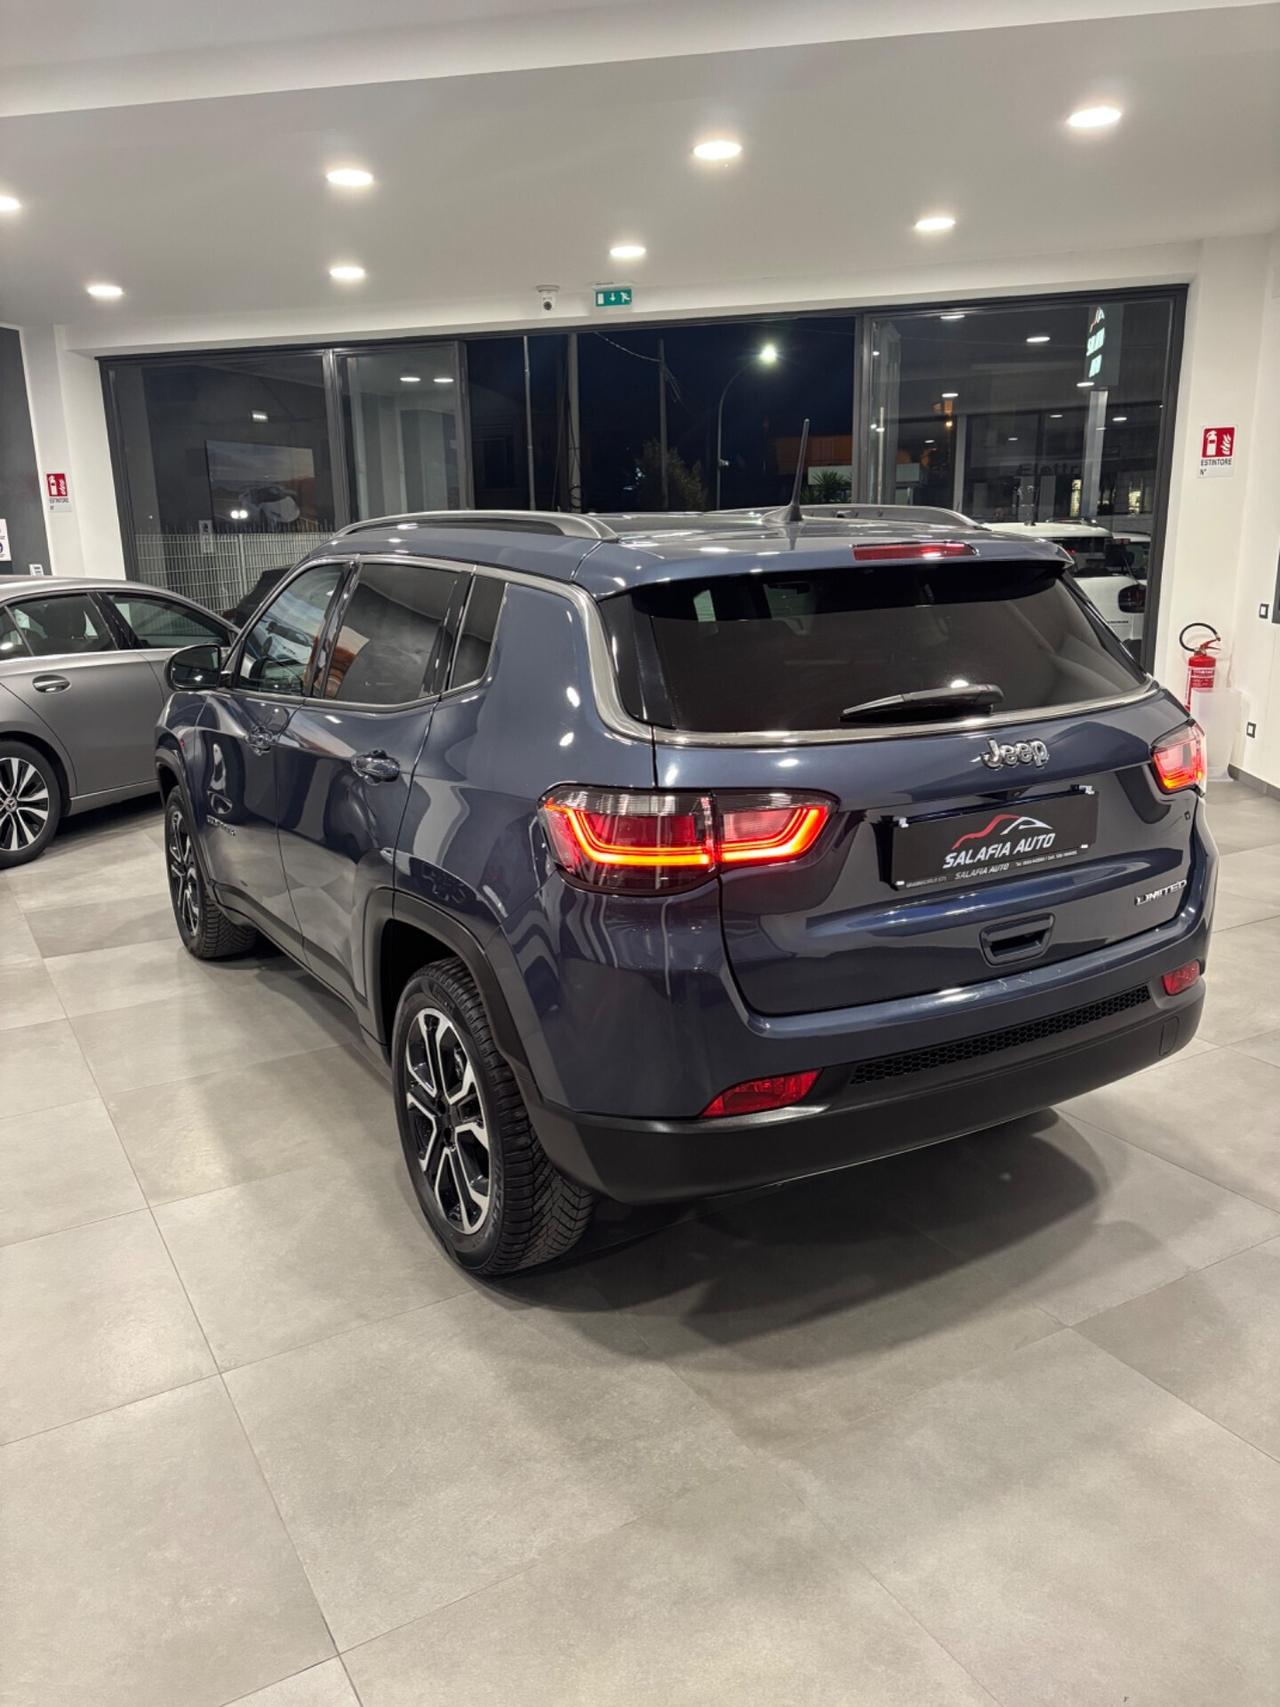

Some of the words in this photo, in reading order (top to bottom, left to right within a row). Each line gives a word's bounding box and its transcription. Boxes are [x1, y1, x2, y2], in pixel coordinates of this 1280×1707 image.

[1200, 458, 1233, 466] ESTINTORE
[982, 738, 1049, 769] Jeep
[943, 842, 1011, 869] SALAFIA
[1013, 833, 1056, 855] AUTO
[954, 866, 988, 880] SALAFIA
[989, 863, 1010, 873] AUTO
[1135, 879, 1187, 906] LIMITED
